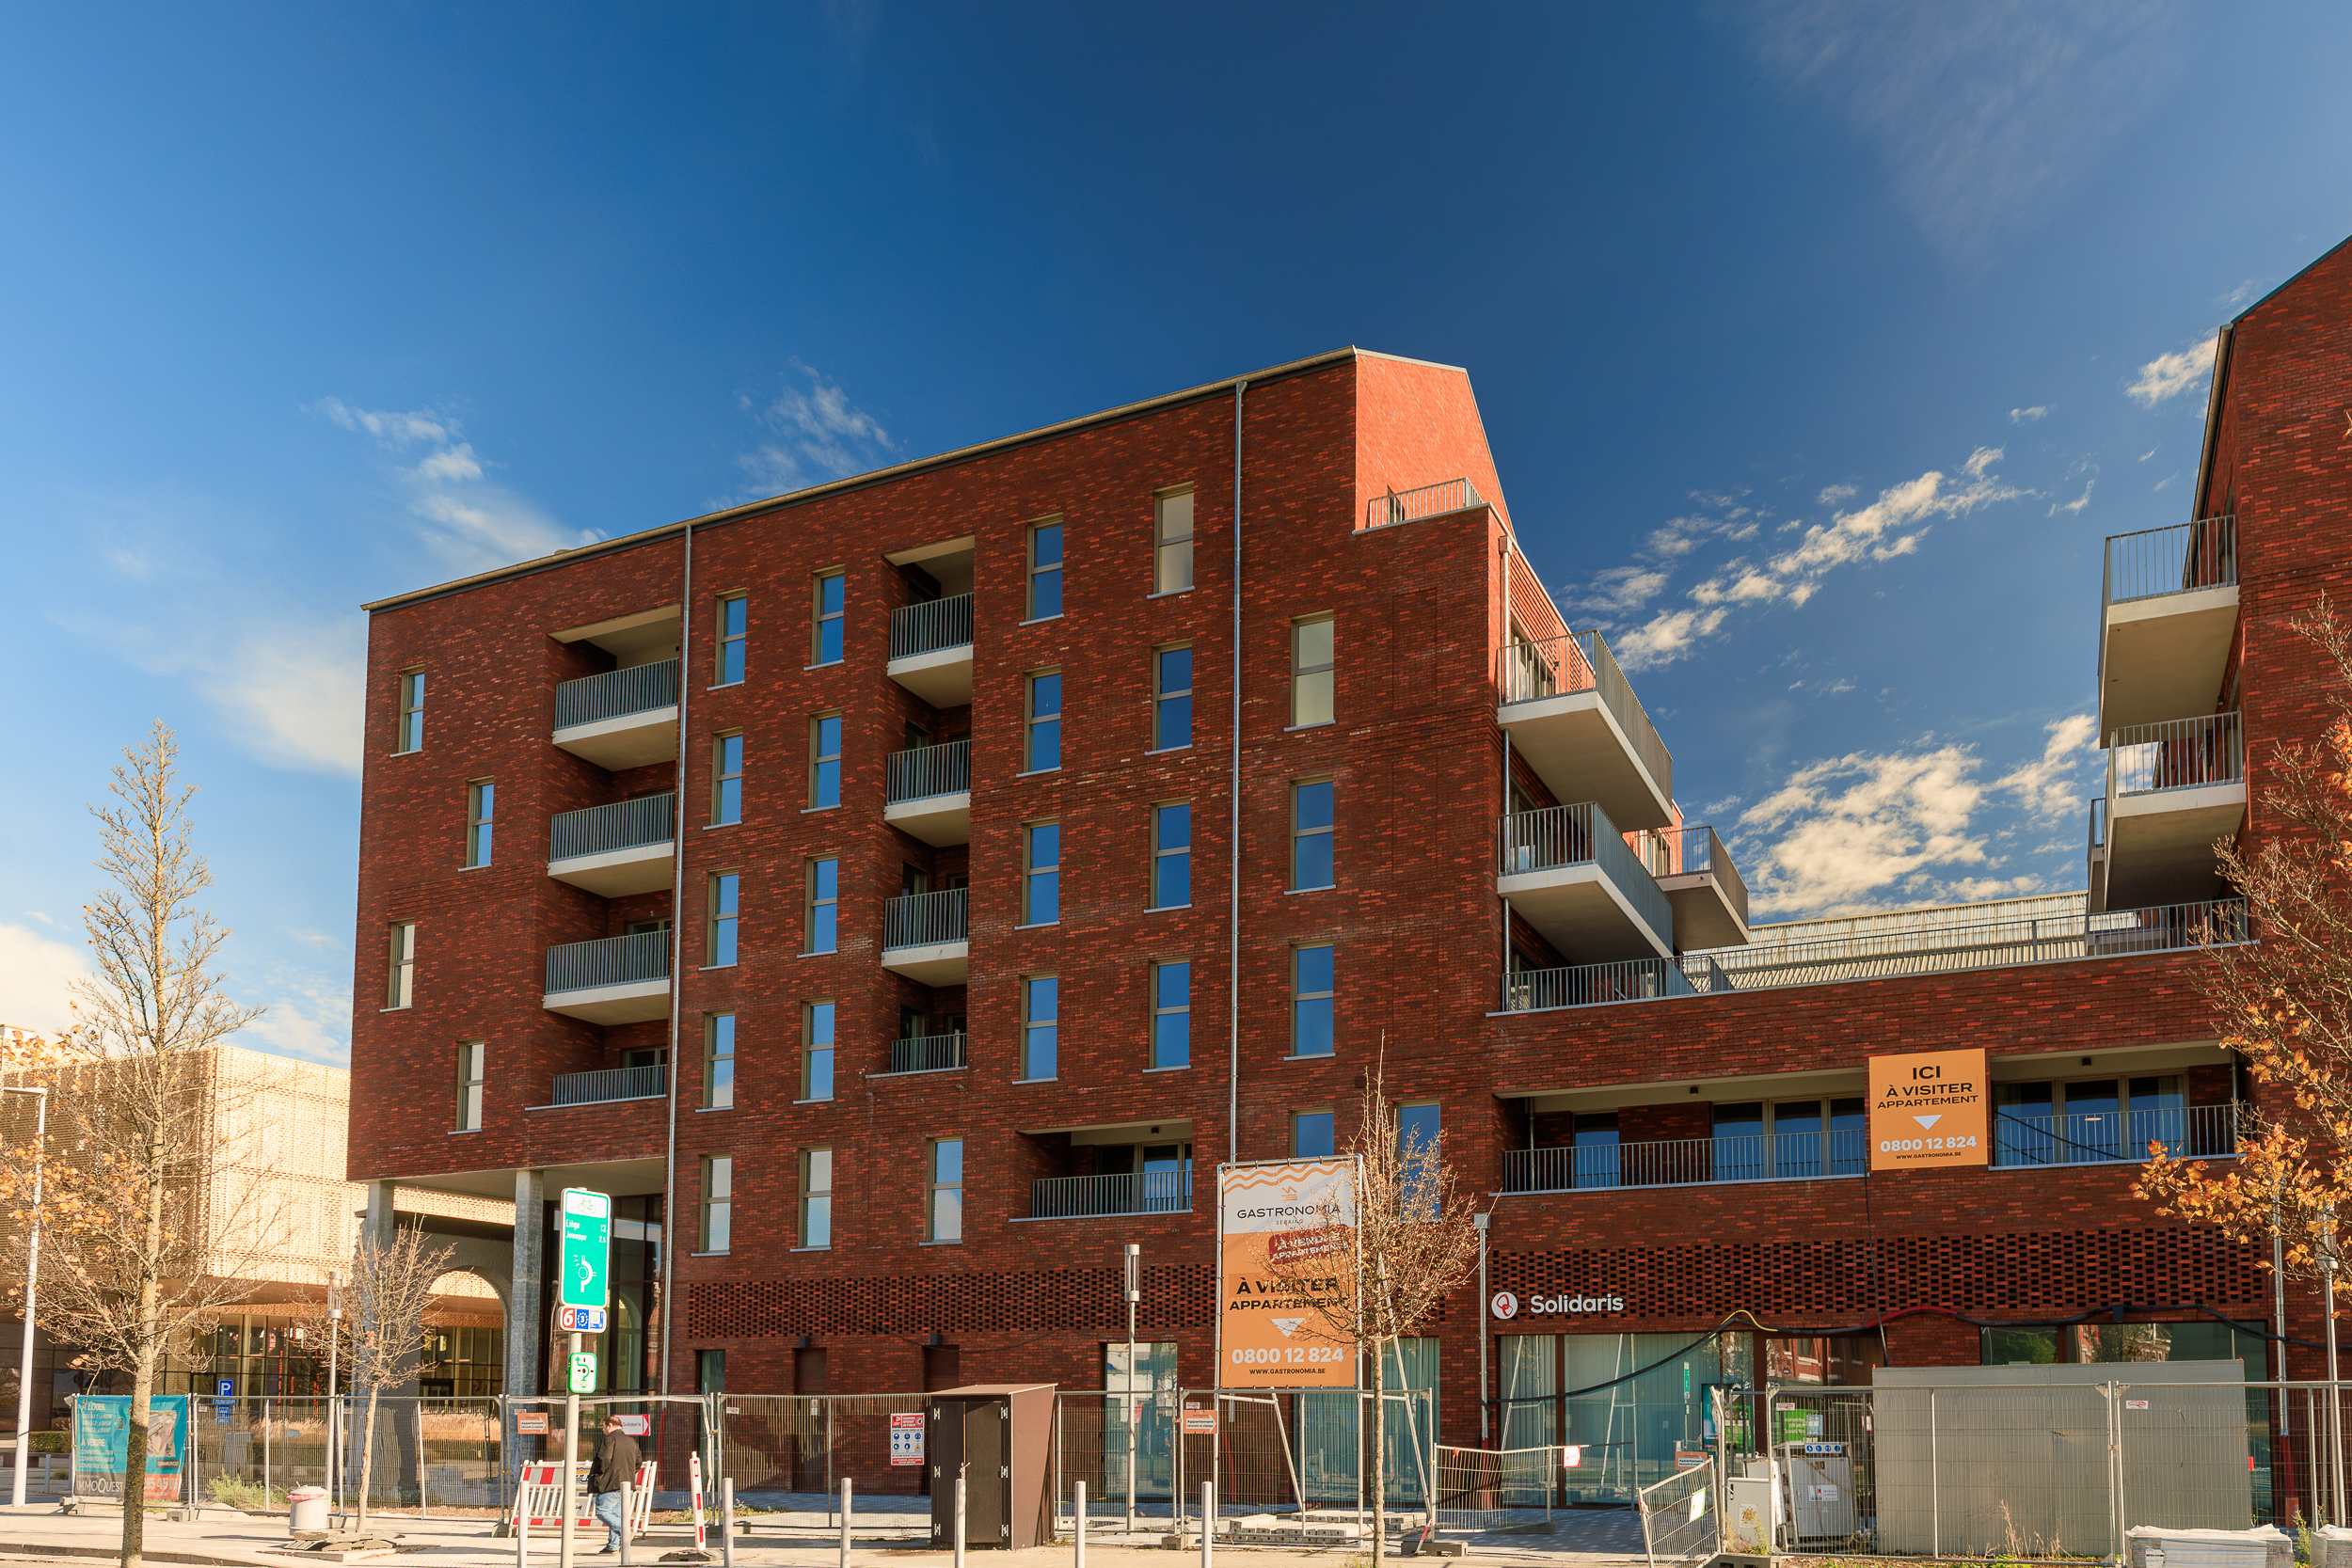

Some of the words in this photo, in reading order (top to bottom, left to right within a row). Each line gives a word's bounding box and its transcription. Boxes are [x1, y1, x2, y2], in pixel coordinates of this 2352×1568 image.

[1913, 1066, 1940, 1080] ICI
[1886, 1085, 1899, 1098] À
[1902, 1083, 1973, 1097] VISITER
[1877, 1095, 1979, 1109] APPARTEMENT
[1880, 1139, 1923, 1152] 0800
[1925, 1137, 1944, 1150] 12
[1946, 1135, 1978, 1148] 824
[1237, 1204, 1341, 1219] GASTRONOMIA
[565, 1219, 580, 1230] Liège
[1236, 1277, 1251, 1294] À
[1530, 1292, 1625, 1314] Solidaris
[564, 1309, 574, 1326] 6
[1232, 1348, 1280, 1365] 0800
[1284, 1347, 1305, 1363] 12
[1308, 1346, 1344, 1363] 824
[221, 1383, 230, 1396] P
[156, 1478, 168, 1490] 45
